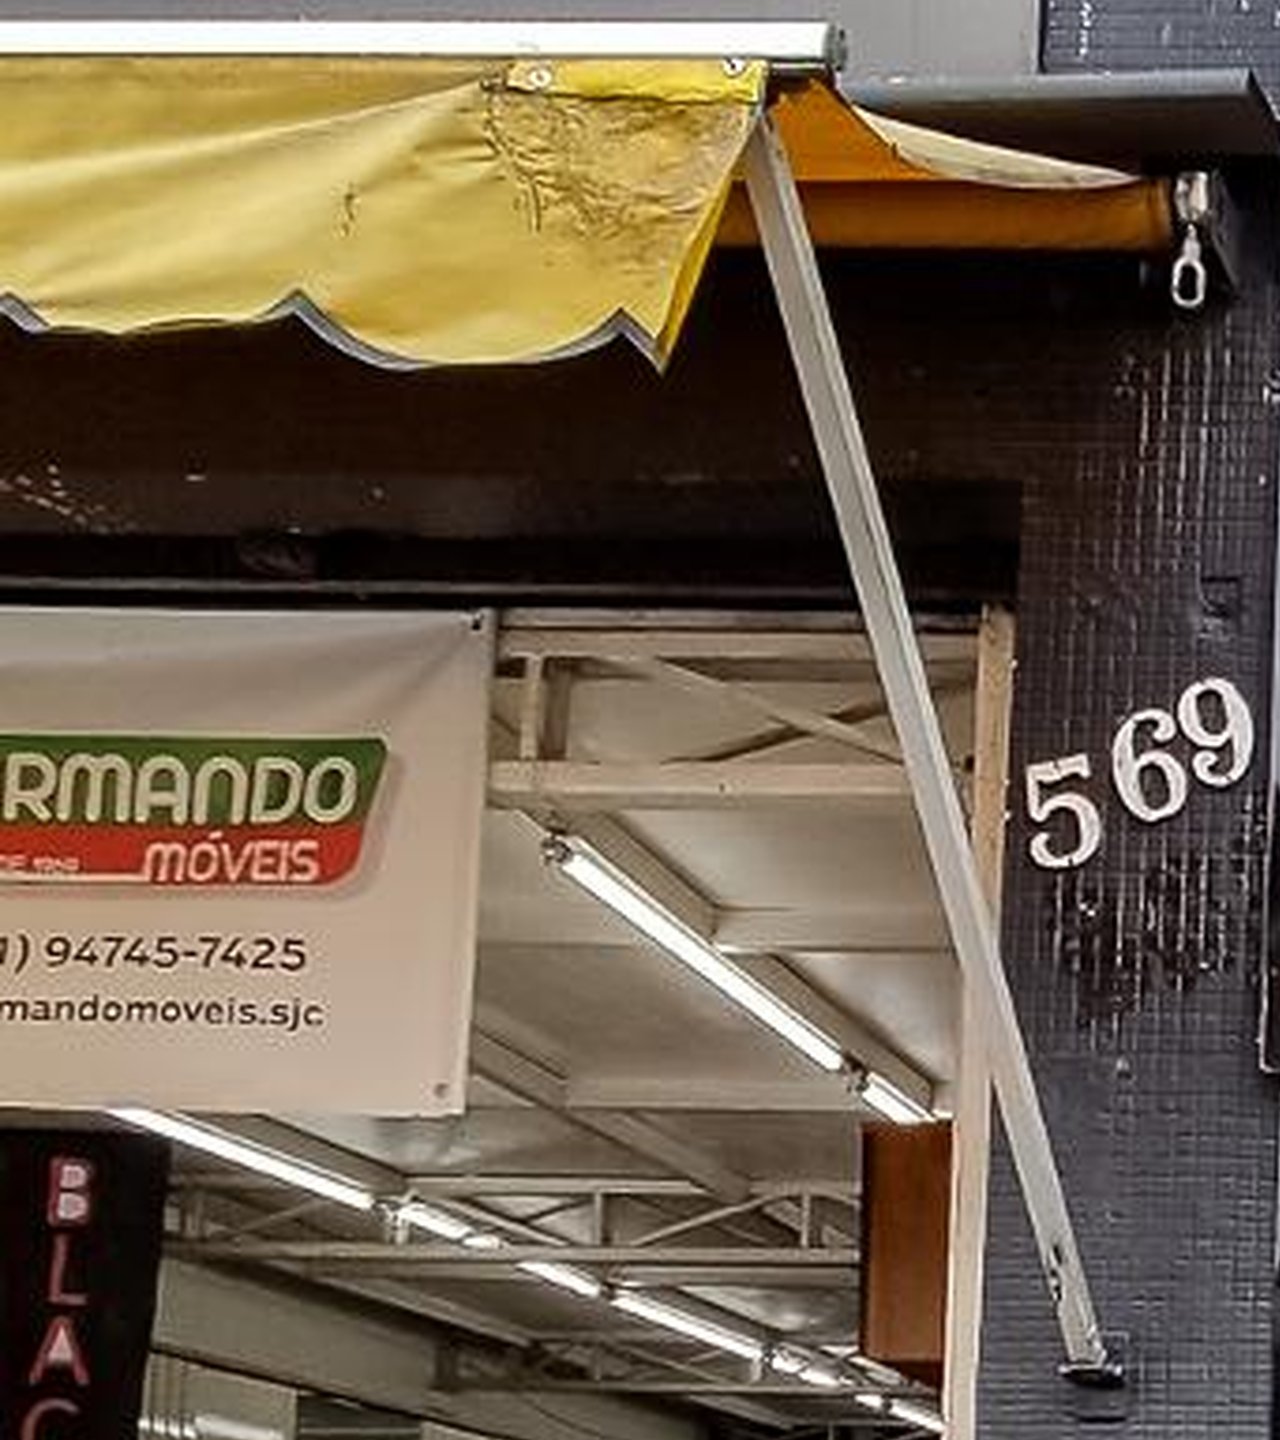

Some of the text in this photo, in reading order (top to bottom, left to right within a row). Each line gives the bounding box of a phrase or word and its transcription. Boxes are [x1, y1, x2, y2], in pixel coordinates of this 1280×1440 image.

[1025, 677, 1254, 869] 569
[143, 831, 320, 882] MÓVEIS
[45, 936, 307, 970] 94745-7425
